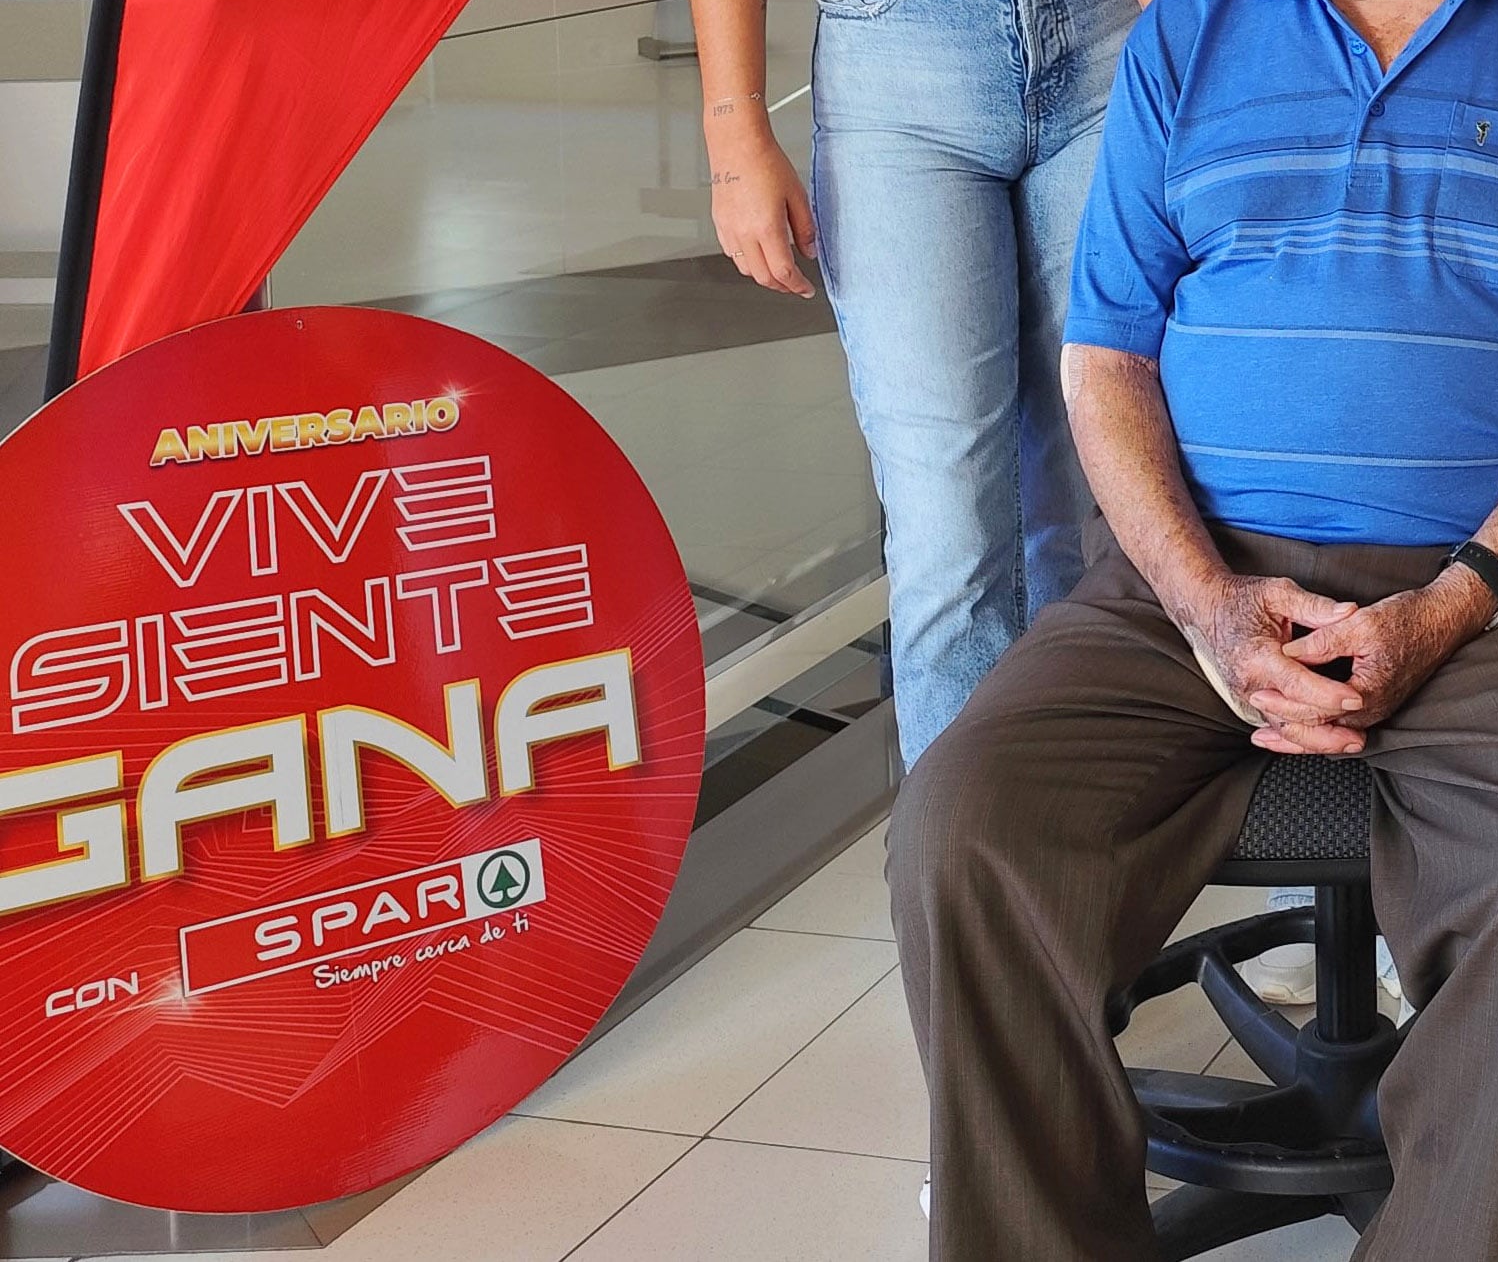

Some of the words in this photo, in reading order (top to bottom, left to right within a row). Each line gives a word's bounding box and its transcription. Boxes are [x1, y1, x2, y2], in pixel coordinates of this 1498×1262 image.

[148, 396, 461, 467] ANIVERSARIO
[117, 455, 497, 588] VIVE
[10, 543, 595, 735] SIENTE
[0, 647, 643, 916] GANA
[254, 872, 462, 963] SPAR
[313, 955, 407, 988] Siempre
[415, 935, 471, 962] cerca
[480, 920, 506, 944] de
[512, 912, 530, 934] ti
[45, 971, 139, 1018] CON
